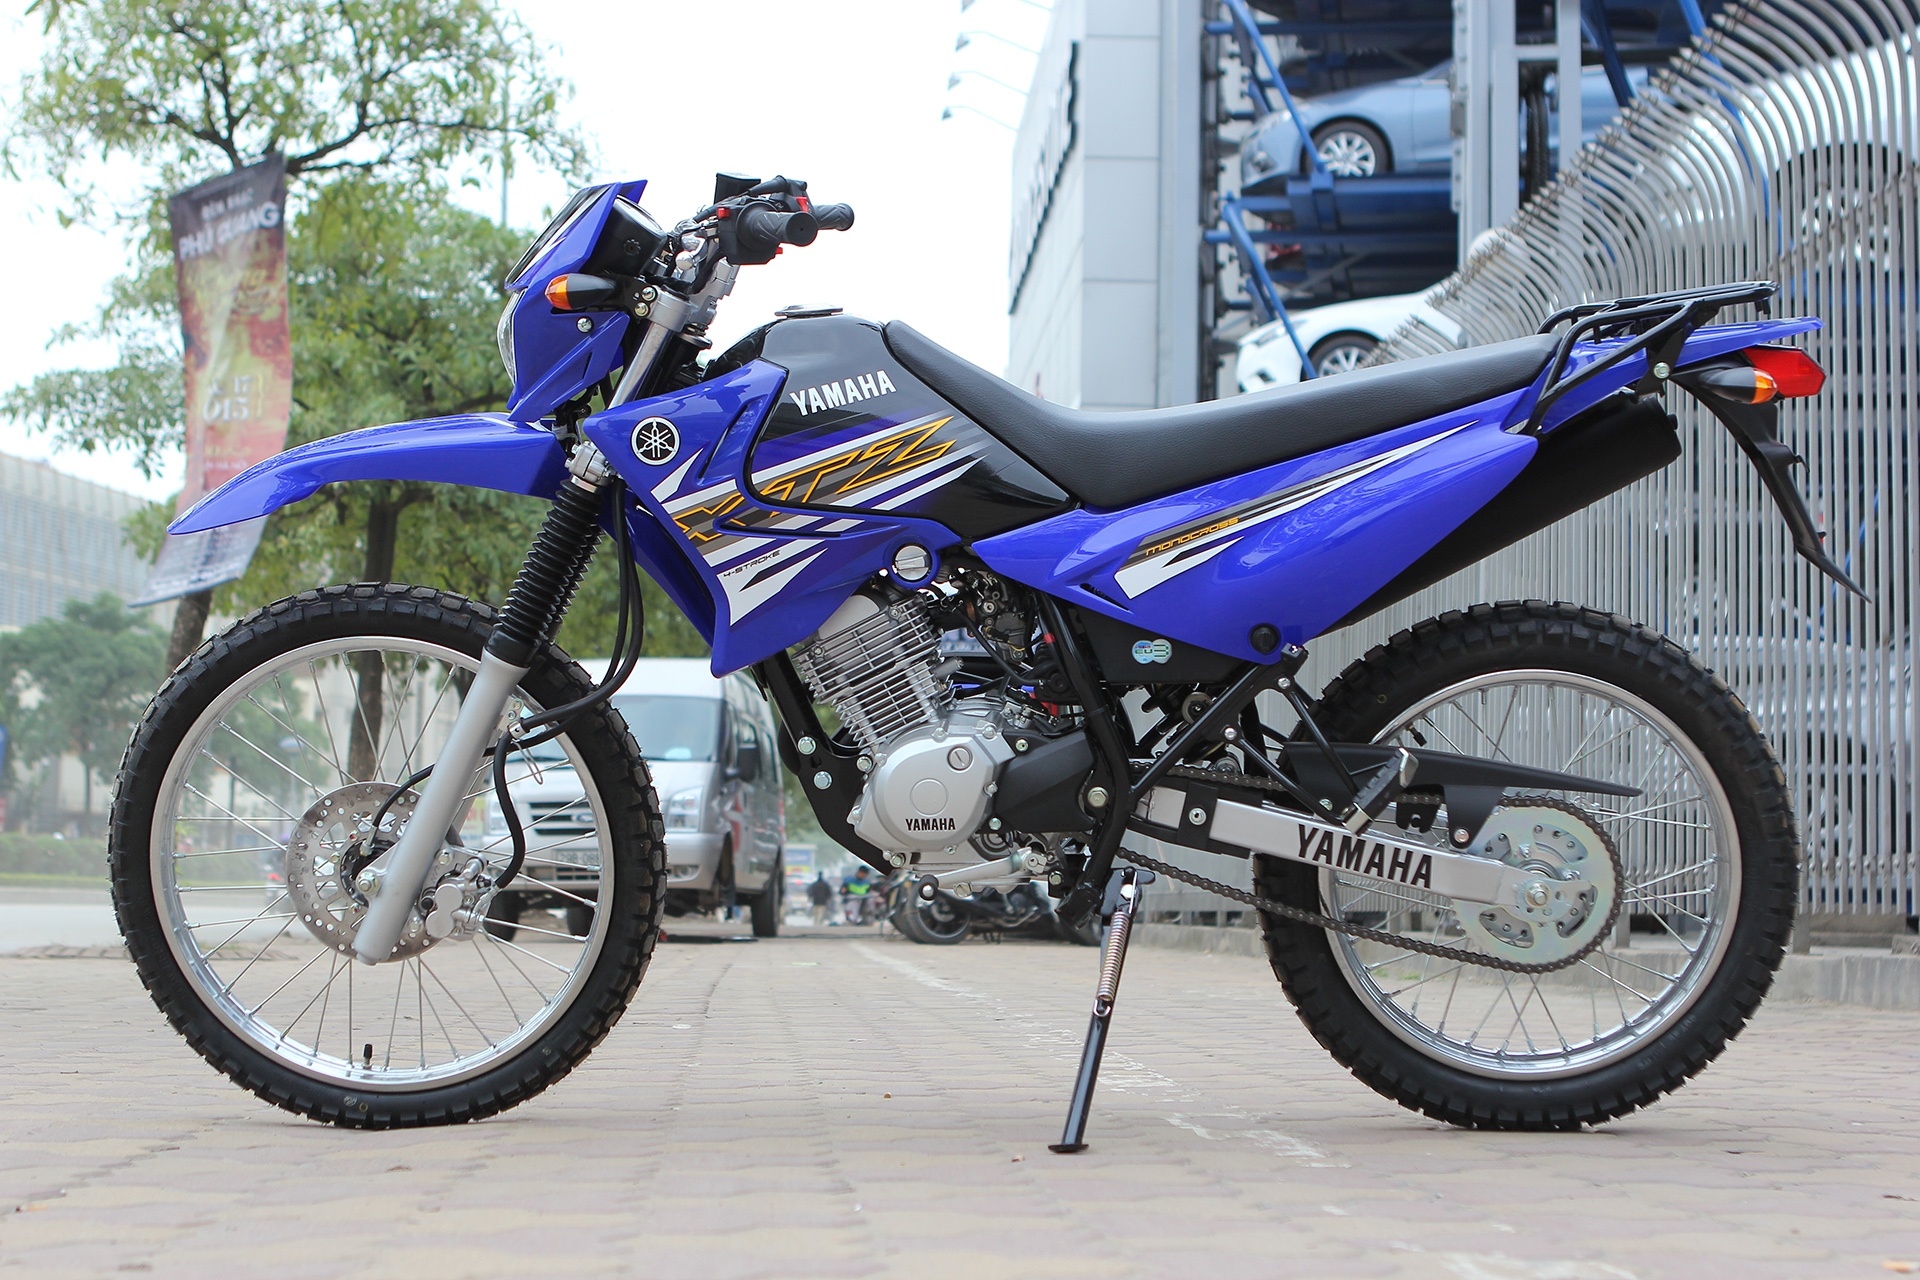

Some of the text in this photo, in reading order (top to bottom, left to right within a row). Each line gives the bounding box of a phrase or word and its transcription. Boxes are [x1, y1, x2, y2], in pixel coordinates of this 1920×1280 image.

[790, 370, 897, 416] YAMAHA
[723, 550, 781, 578] 4-STROKE
[905, 818, 956, 831] YAMAHA
[1298, 823, 1433, 889] YAMAHA
